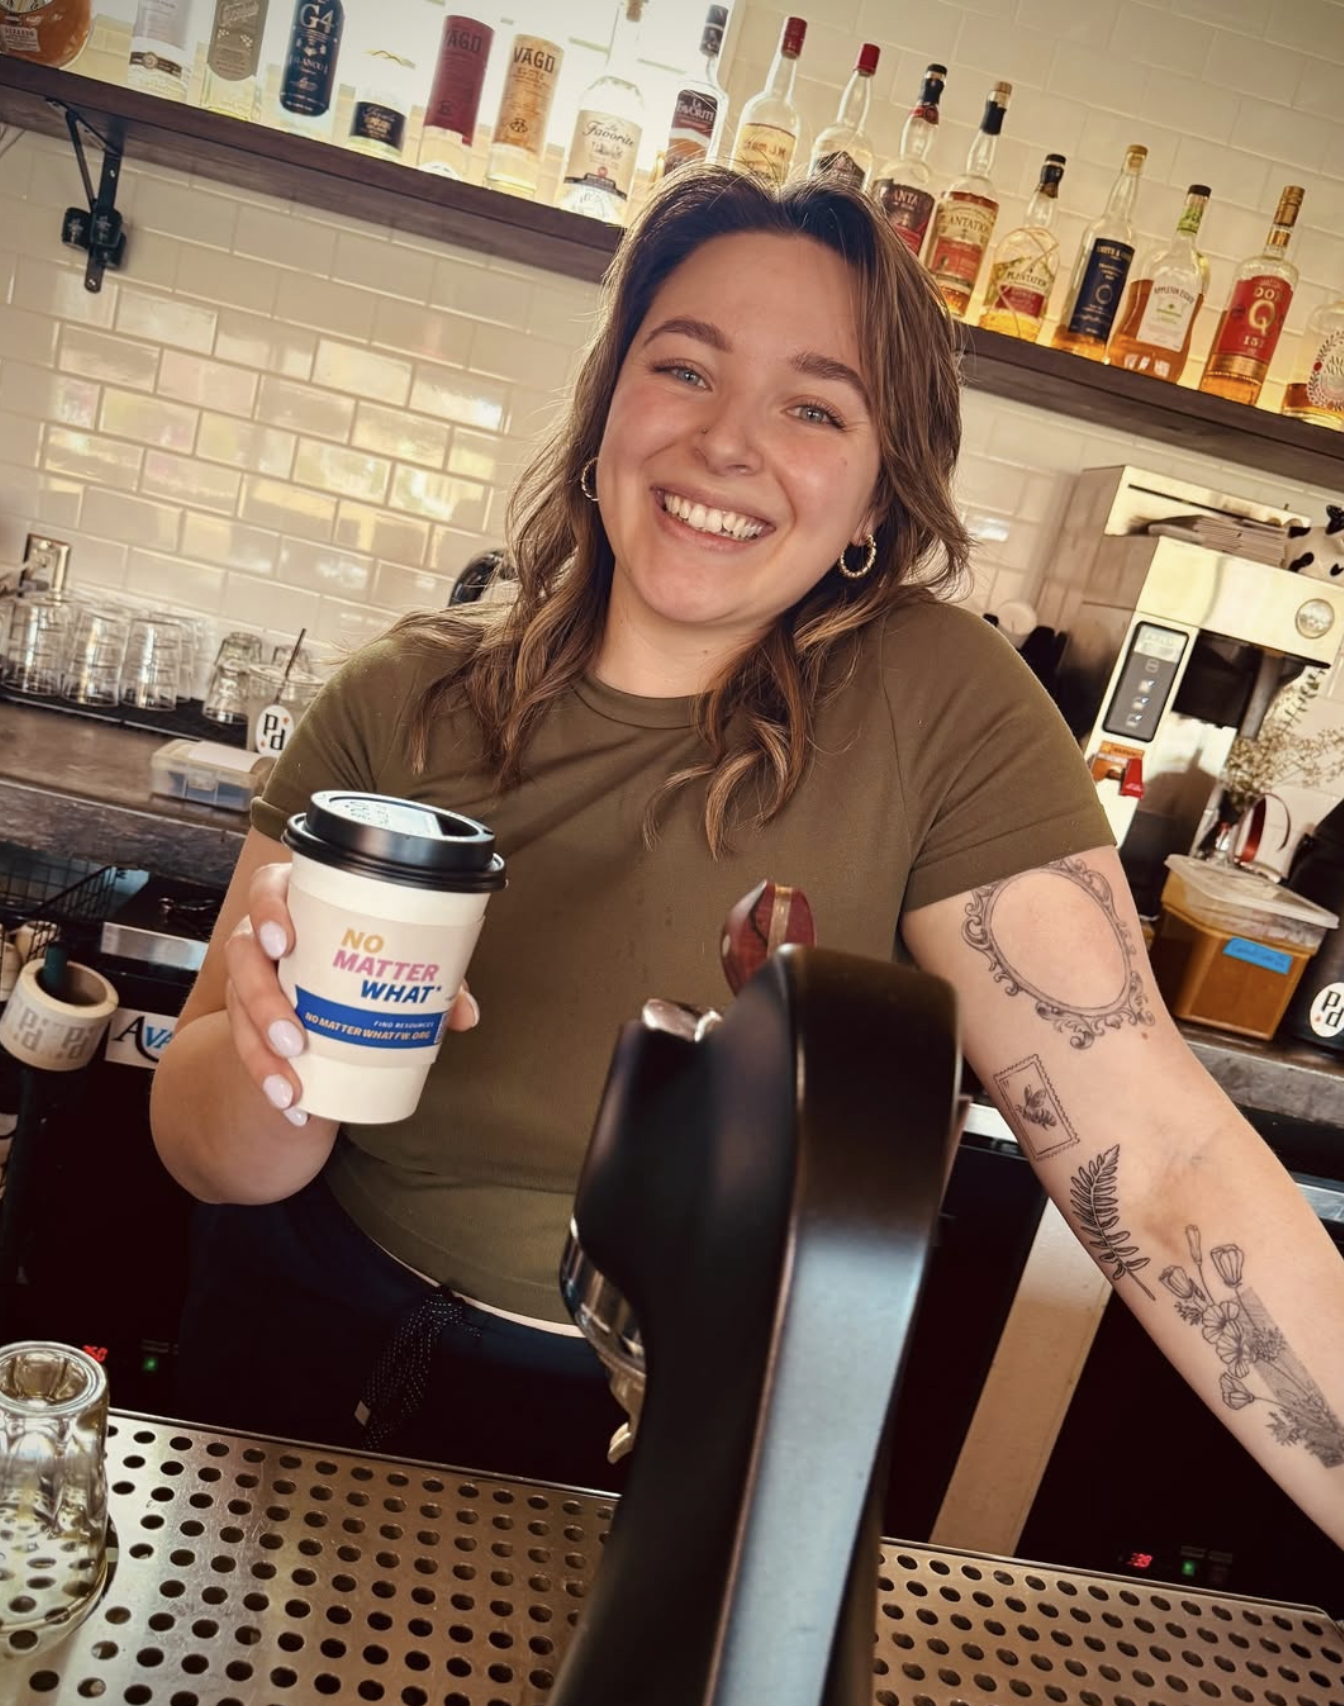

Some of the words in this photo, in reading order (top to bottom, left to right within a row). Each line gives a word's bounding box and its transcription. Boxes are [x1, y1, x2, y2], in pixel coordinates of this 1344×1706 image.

[300, 3, 335, 34] G4
[582, 119, 635, 147] Favorite
[1249, 299, 1276, 337] Q
[341, 928, 385, 954] NO
[332, 949, 440, 982] MATTER
[373, 1020, 393, 1029] FIND
